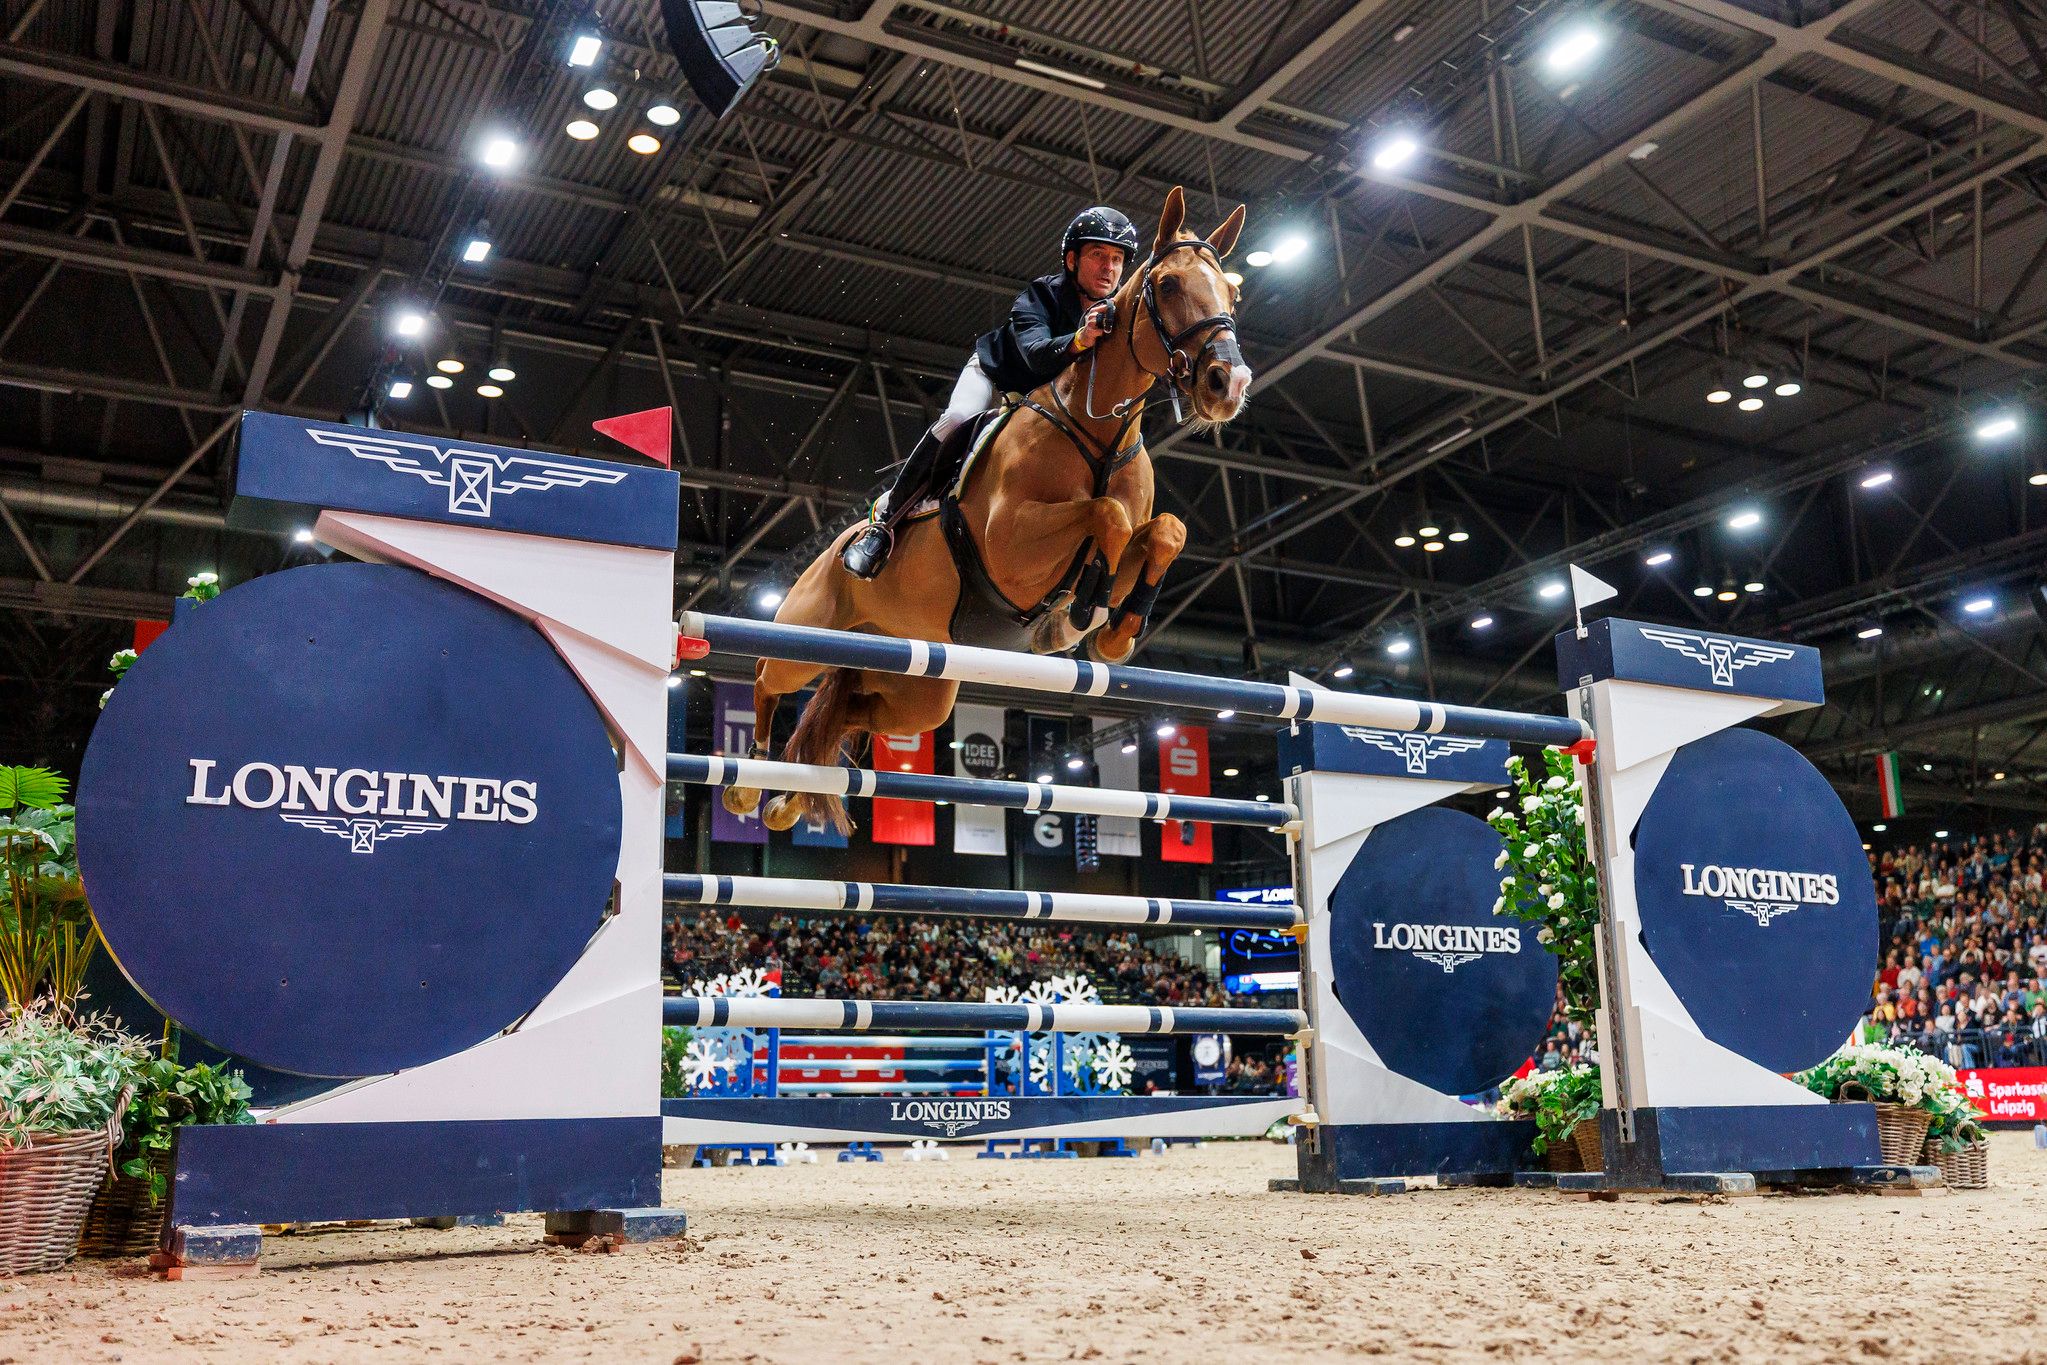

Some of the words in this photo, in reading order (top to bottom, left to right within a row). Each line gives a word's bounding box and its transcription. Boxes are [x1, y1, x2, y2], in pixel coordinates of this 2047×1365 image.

[965, 743, 996, 758] IDEE
[187, 758, 538, 824] LONGINES
[1681, 863, 1840, 906] LONGINES
[1372, 922, 1522, 954] LONGINES
[891, 1100, 1012, 1122] LONGINES
[1990, 1099, 2036, 1117] Leipzig
